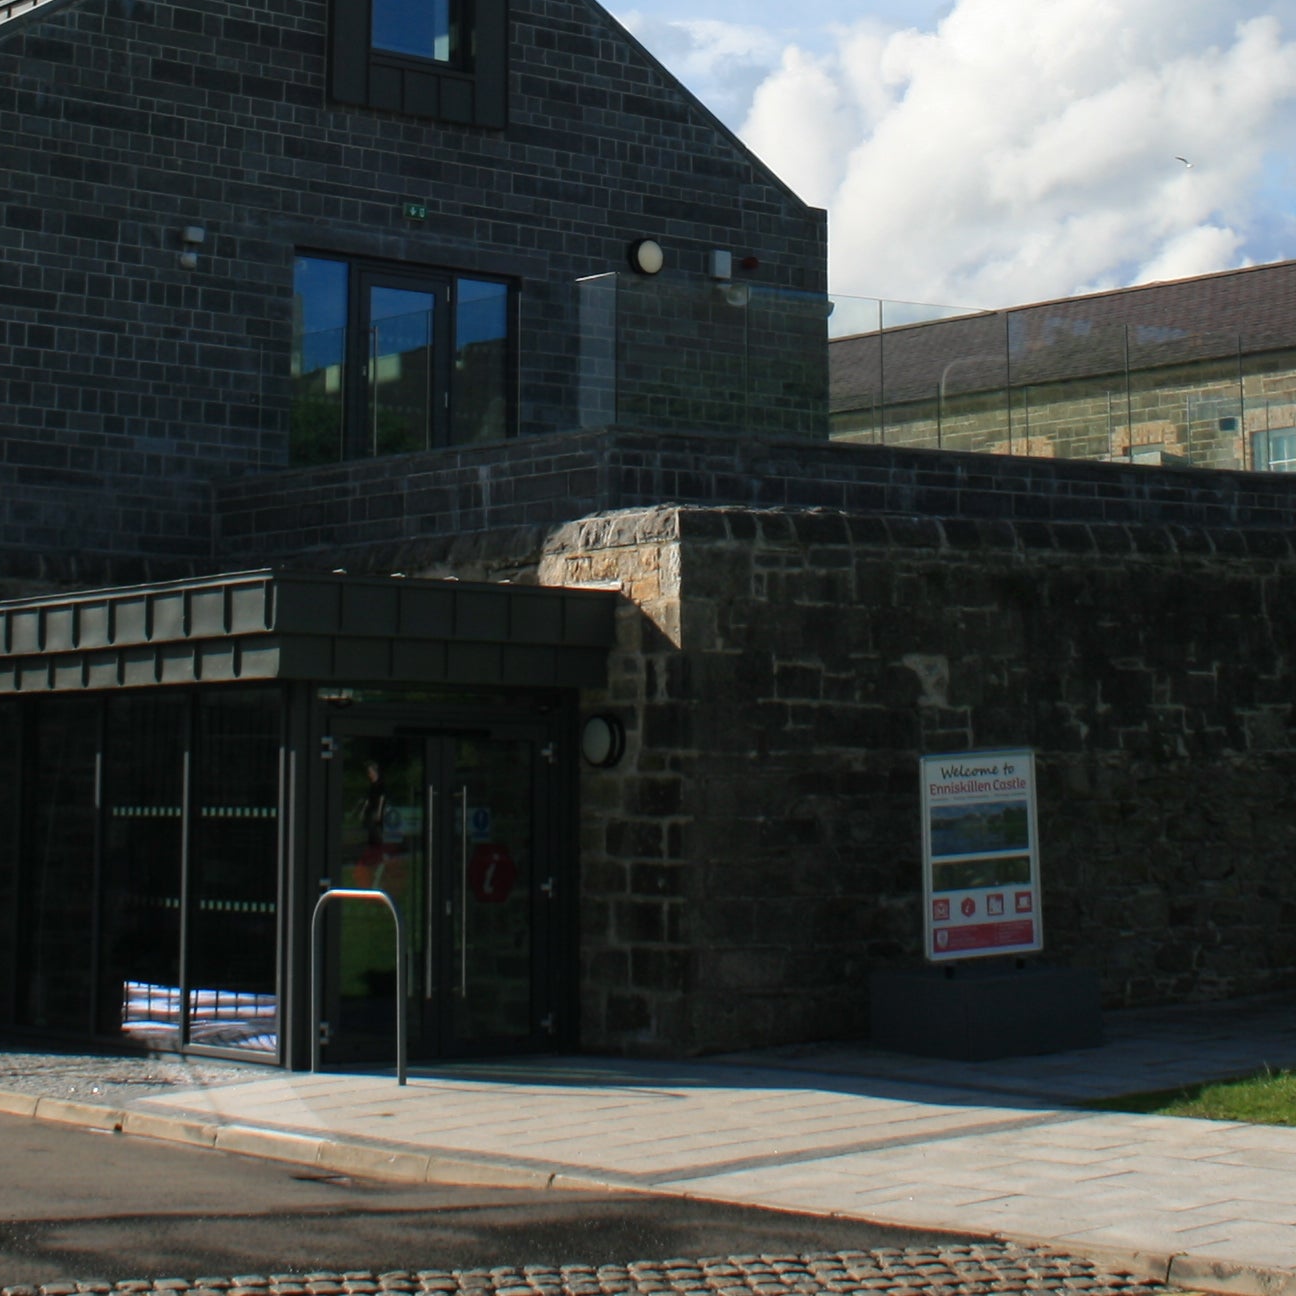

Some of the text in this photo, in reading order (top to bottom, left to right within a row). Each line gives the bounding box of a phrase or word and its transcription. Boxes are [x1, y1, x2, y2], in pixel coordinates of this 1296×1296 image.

[941, 761, 1015, 780] Welcome to
[929, 777, 1026, 796] Enniskillen Castle
